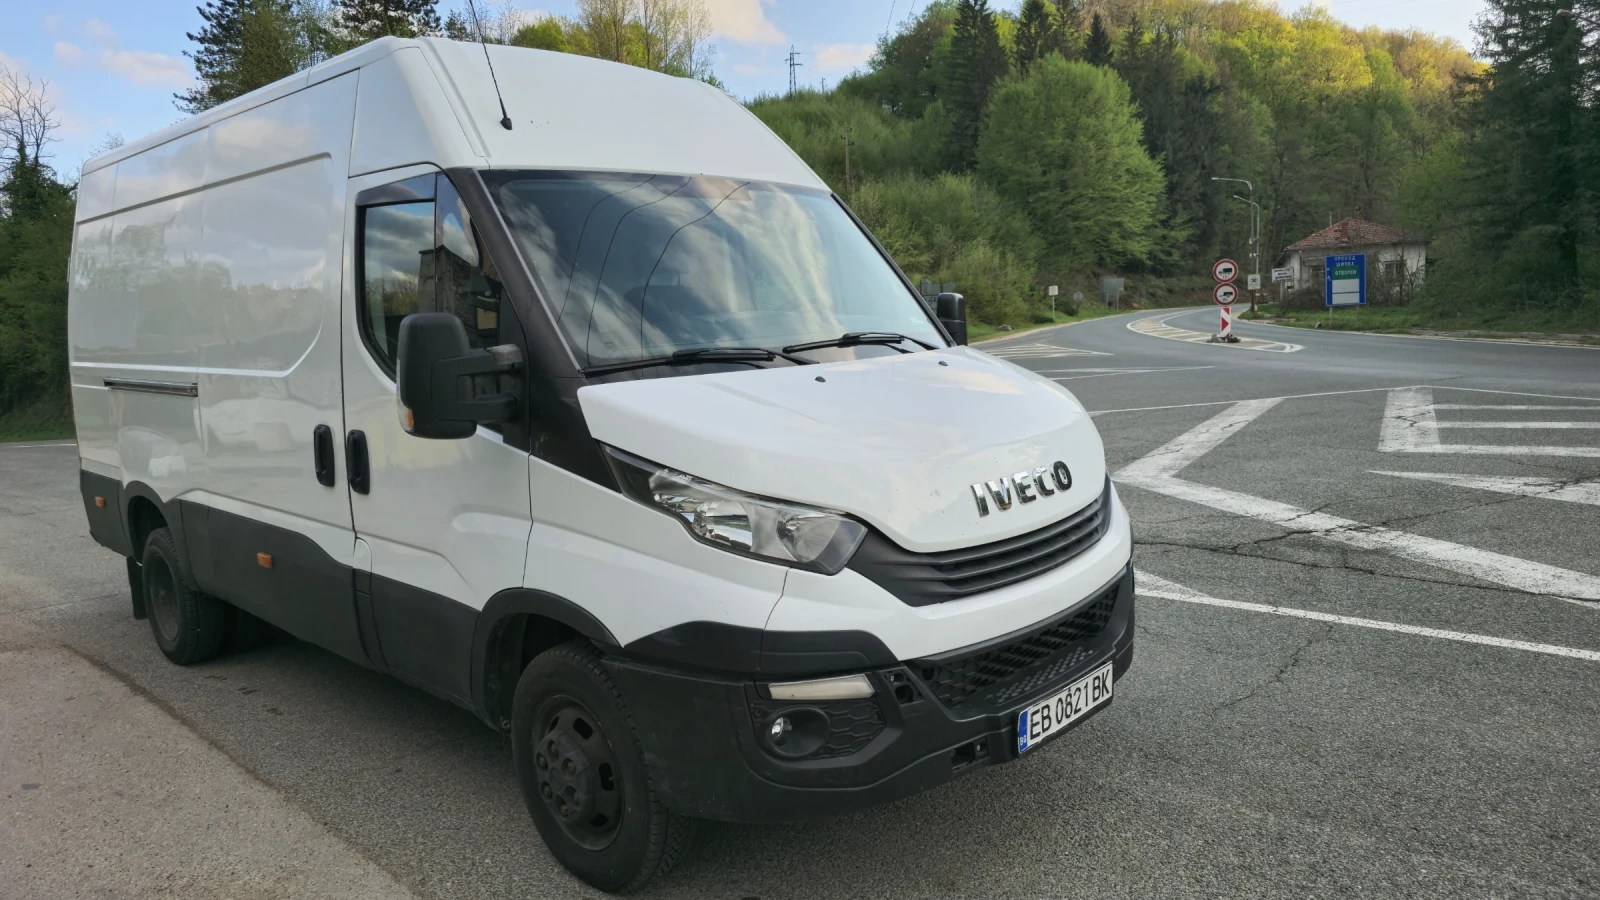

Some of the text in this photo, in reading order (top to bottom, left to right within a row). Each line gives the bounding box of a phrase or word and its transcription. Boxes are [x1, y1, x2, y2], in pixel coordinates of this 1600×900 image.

[970, 460, 1073, 518] IVECO
[1030, 668, 1110, 740] EB 0821 BK
